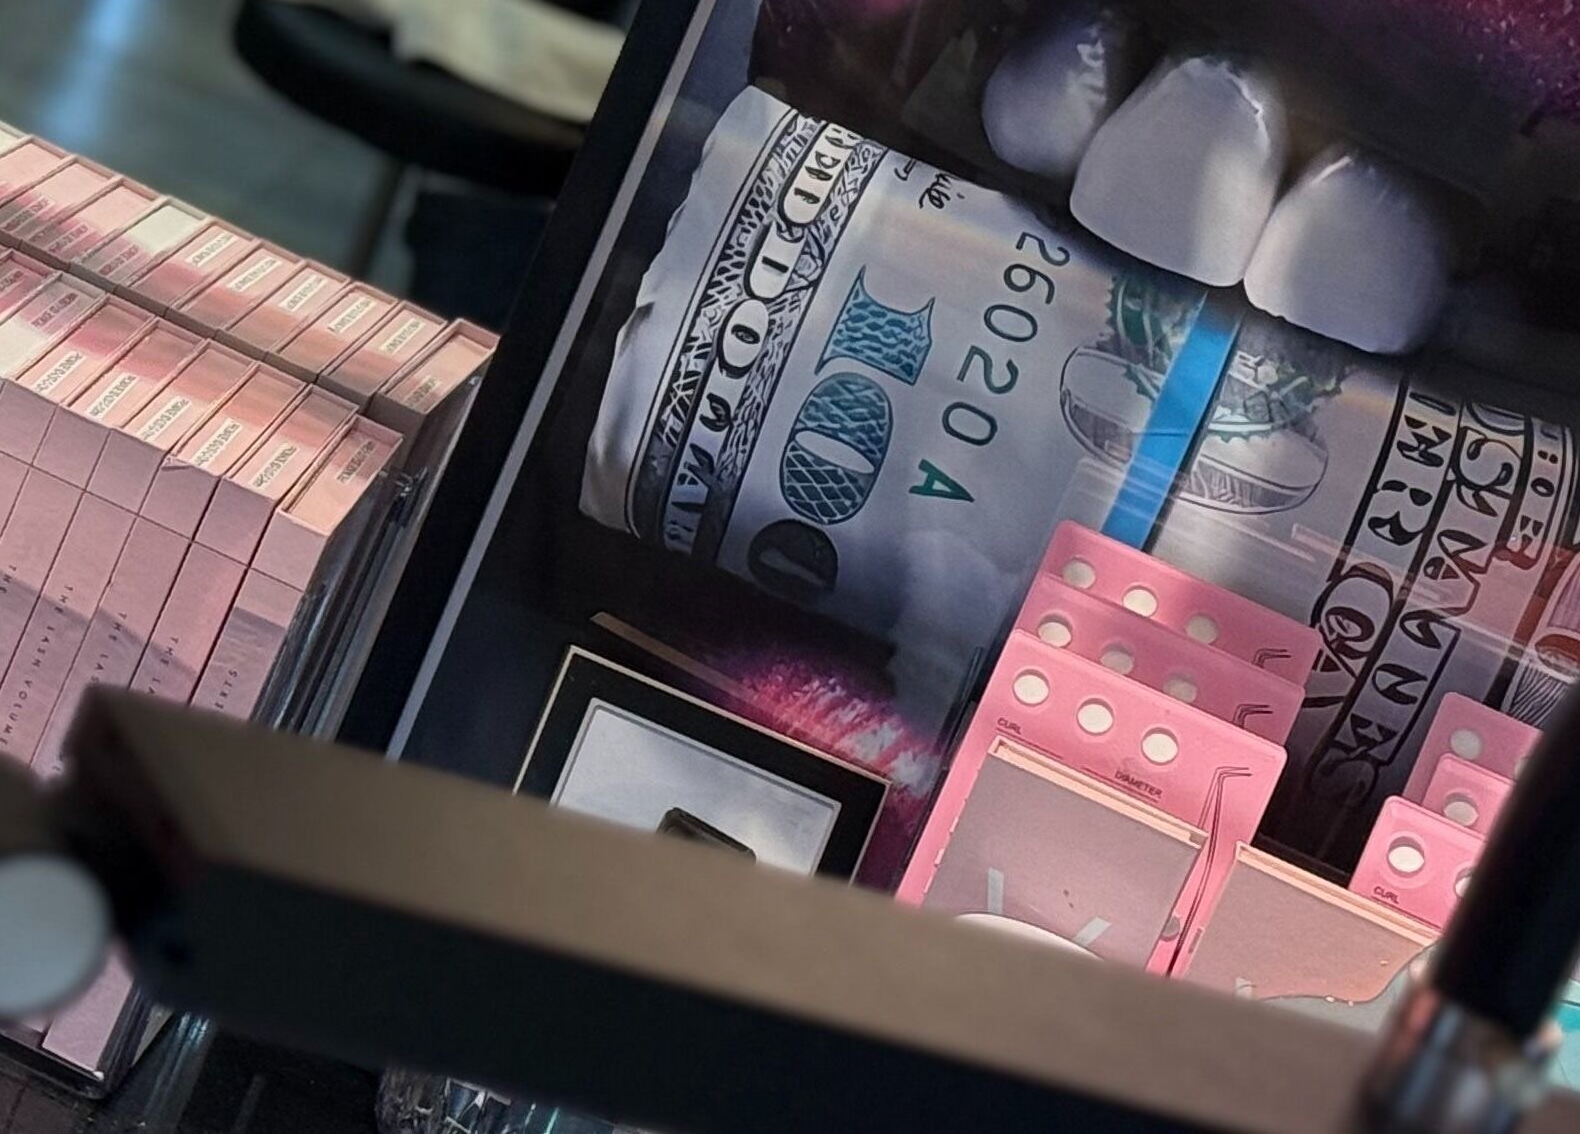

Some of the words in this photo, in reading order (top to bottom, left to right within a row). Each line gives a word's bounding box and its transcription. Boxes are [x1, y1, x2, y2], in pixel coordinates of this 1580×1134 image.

[29, 624, 56, 669] LASH
[995, 716, 1023, 735] CURL
[1112, 769, 1164, 799] DIAMETER
[1371, 885, 1402, 904] CURL
